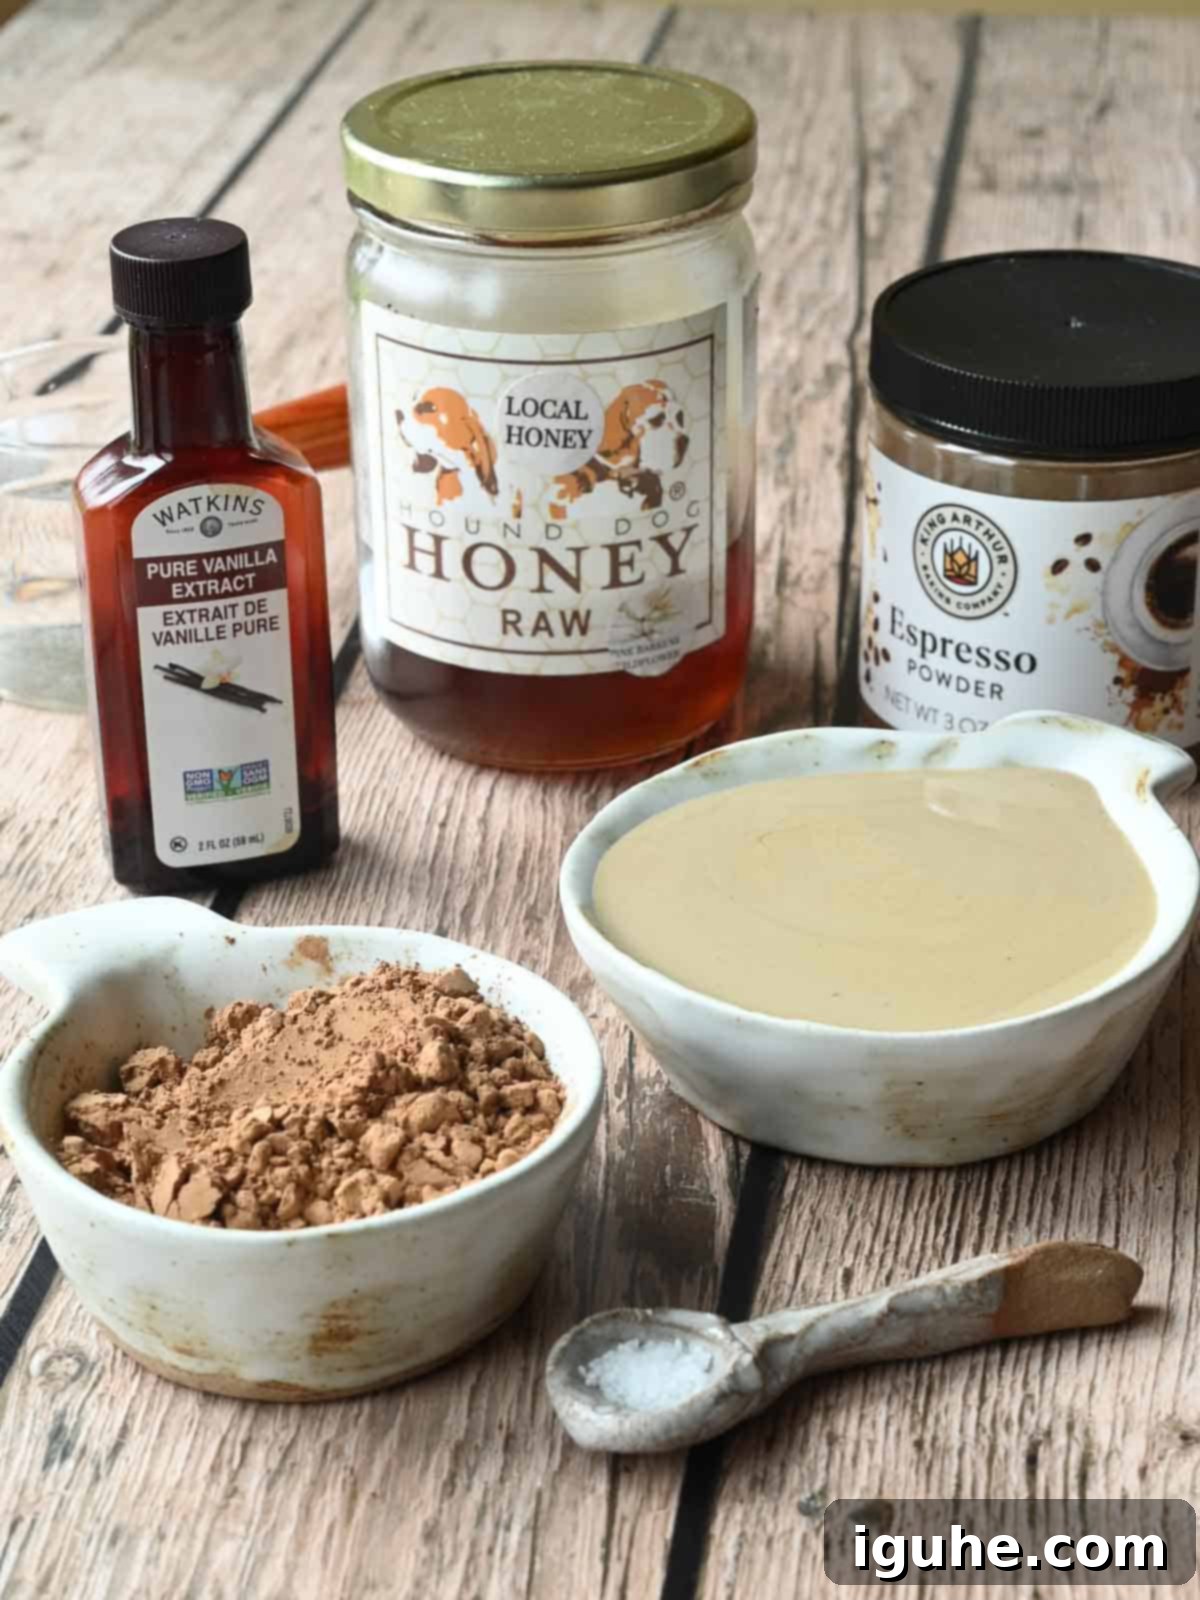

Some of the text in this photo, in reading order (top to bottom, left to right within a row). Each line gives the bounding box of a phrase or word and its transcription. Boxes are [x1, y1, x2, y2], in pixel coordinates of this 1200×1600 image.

[505, 396, 588, 421] LOCAL
[504, 425, 594, 450] HONEY
[152, 494, 265, 528] WATKINS
[400, 500, 700, 541] HOUND DOG
[920, 511, 1009, 565] KING ARTHUR
[146, 548, 277, 580] PURE VANILLA
[400, 522, 699, 594] HONEY
[171, 573, 256, 600] EXTRACT
[921, 563, 1004, 611] BAKING COMPANY
[162, 598, 268, 627] EXTRAIT DE
[501, 608, 592, 638] RAW
[152, 615, 280, 647] VANILLE PURE
[890, 605, 1038, 675] Espresso
[907, 658, 1004, 701] POWDER
[884, 685, 912, 714] NET
[914, 701, 940, 725] WT
[943, 713, 954, 731] 3
[205, 840, 217, 850] FL
[218, 838, 231, 849] OZ
